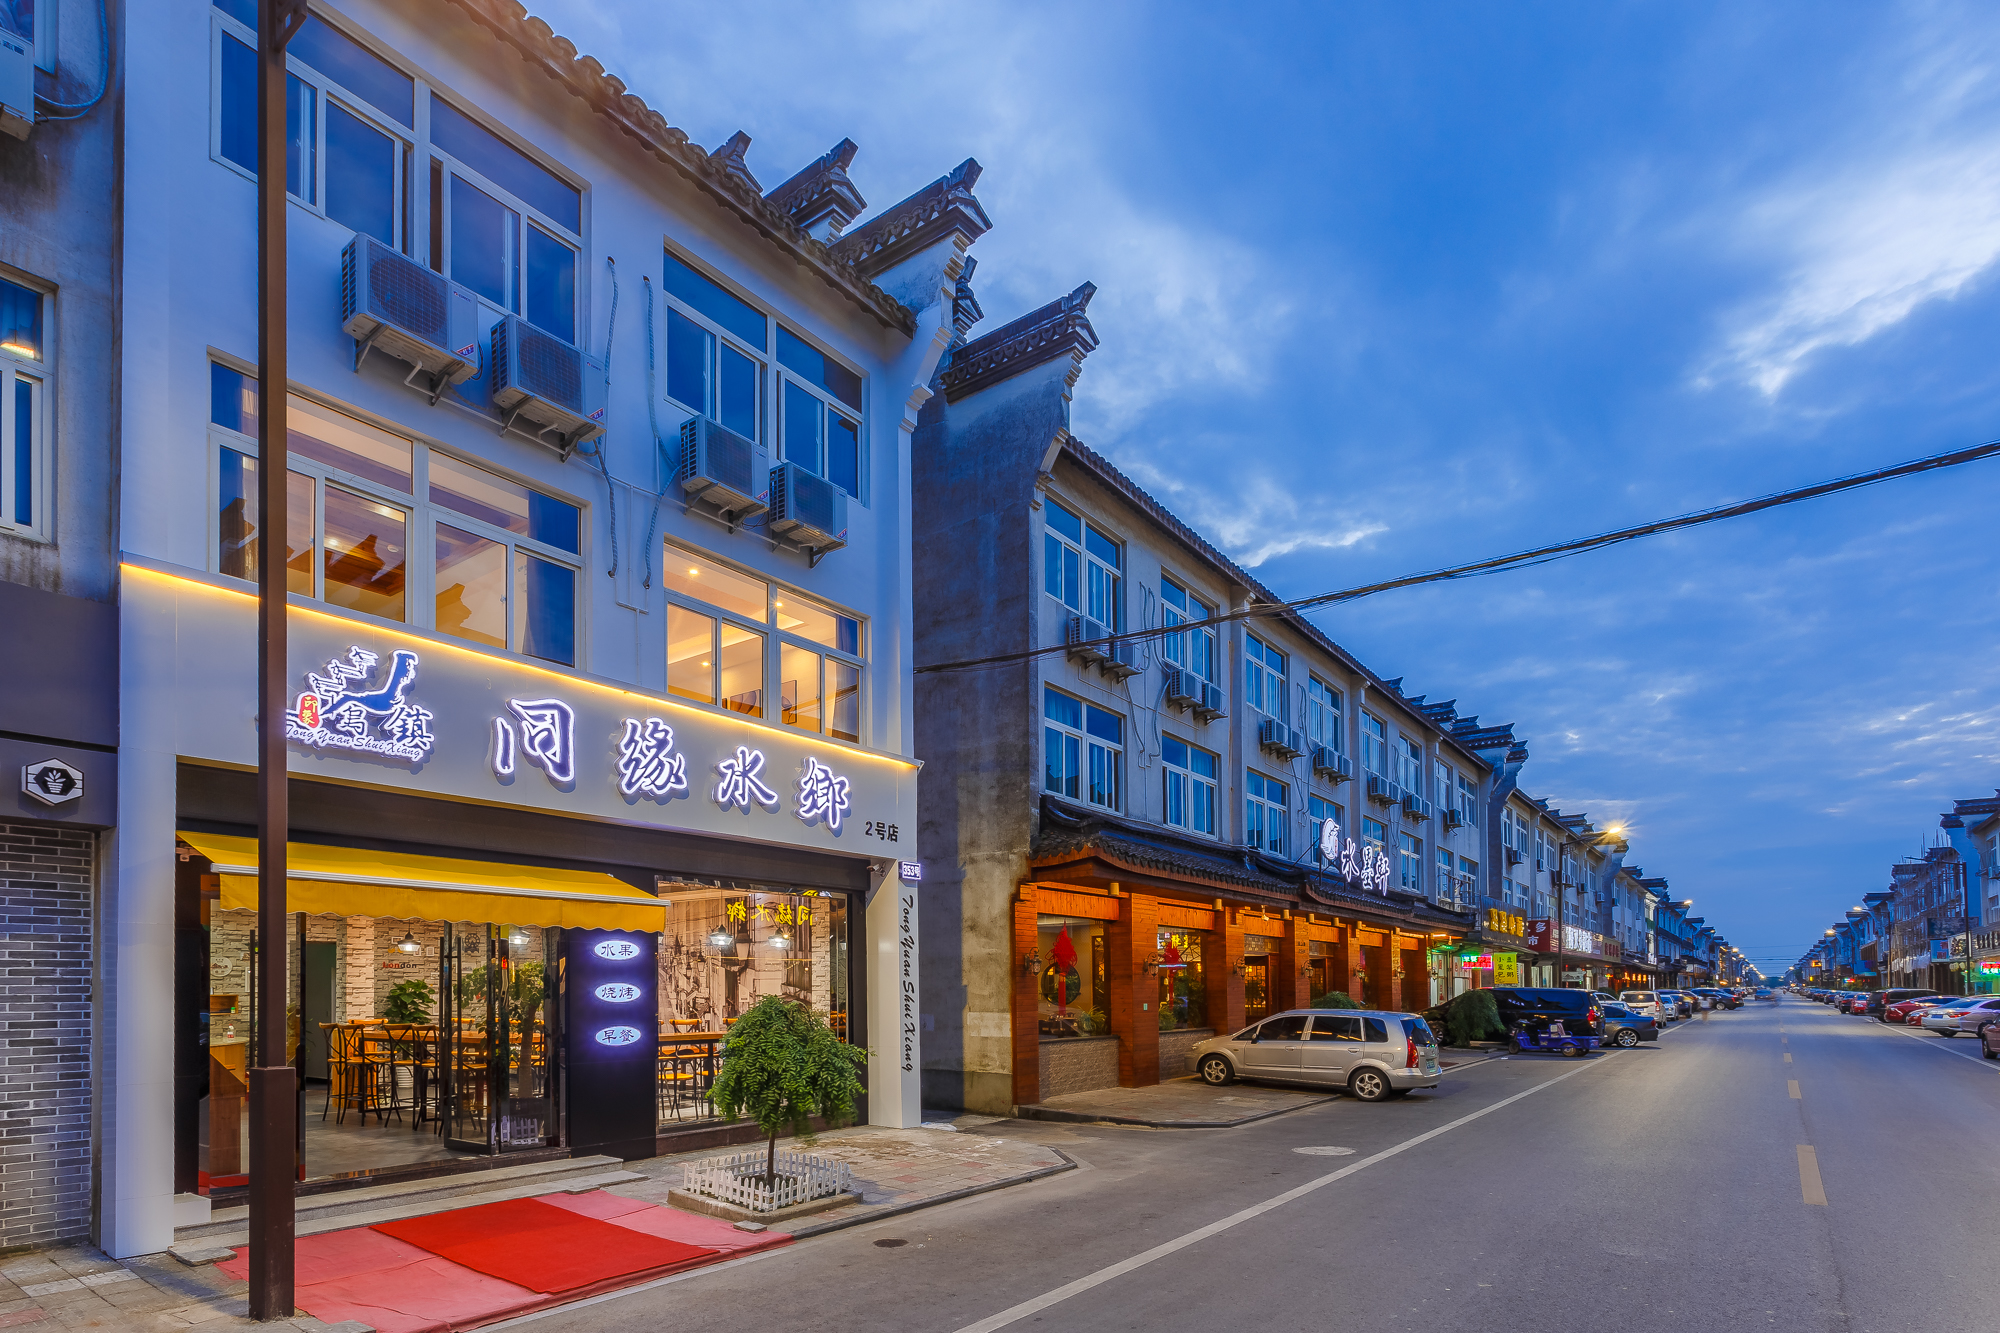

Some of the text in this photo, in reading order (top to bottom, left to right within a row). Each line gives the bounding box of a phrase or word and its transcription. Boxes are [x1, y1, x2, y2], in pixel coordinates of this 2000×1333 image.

[316, 729, 350, 745] Yuan
[354, 737, 384, 750] Shui
[387, 742, 422, 758] Xiang
[865, 820, 899, 842] 2号店
[904, 864, 920, 877] 353号
[600, 943, 634, 957] 水果
[382, 961, 417, 969] London
[900, 894, 915, 1073] Tong Yuan Shui Xiang
[601, 986, 635, 1000] 烧烤
[602, 1029, 635, 1043] 早餐
